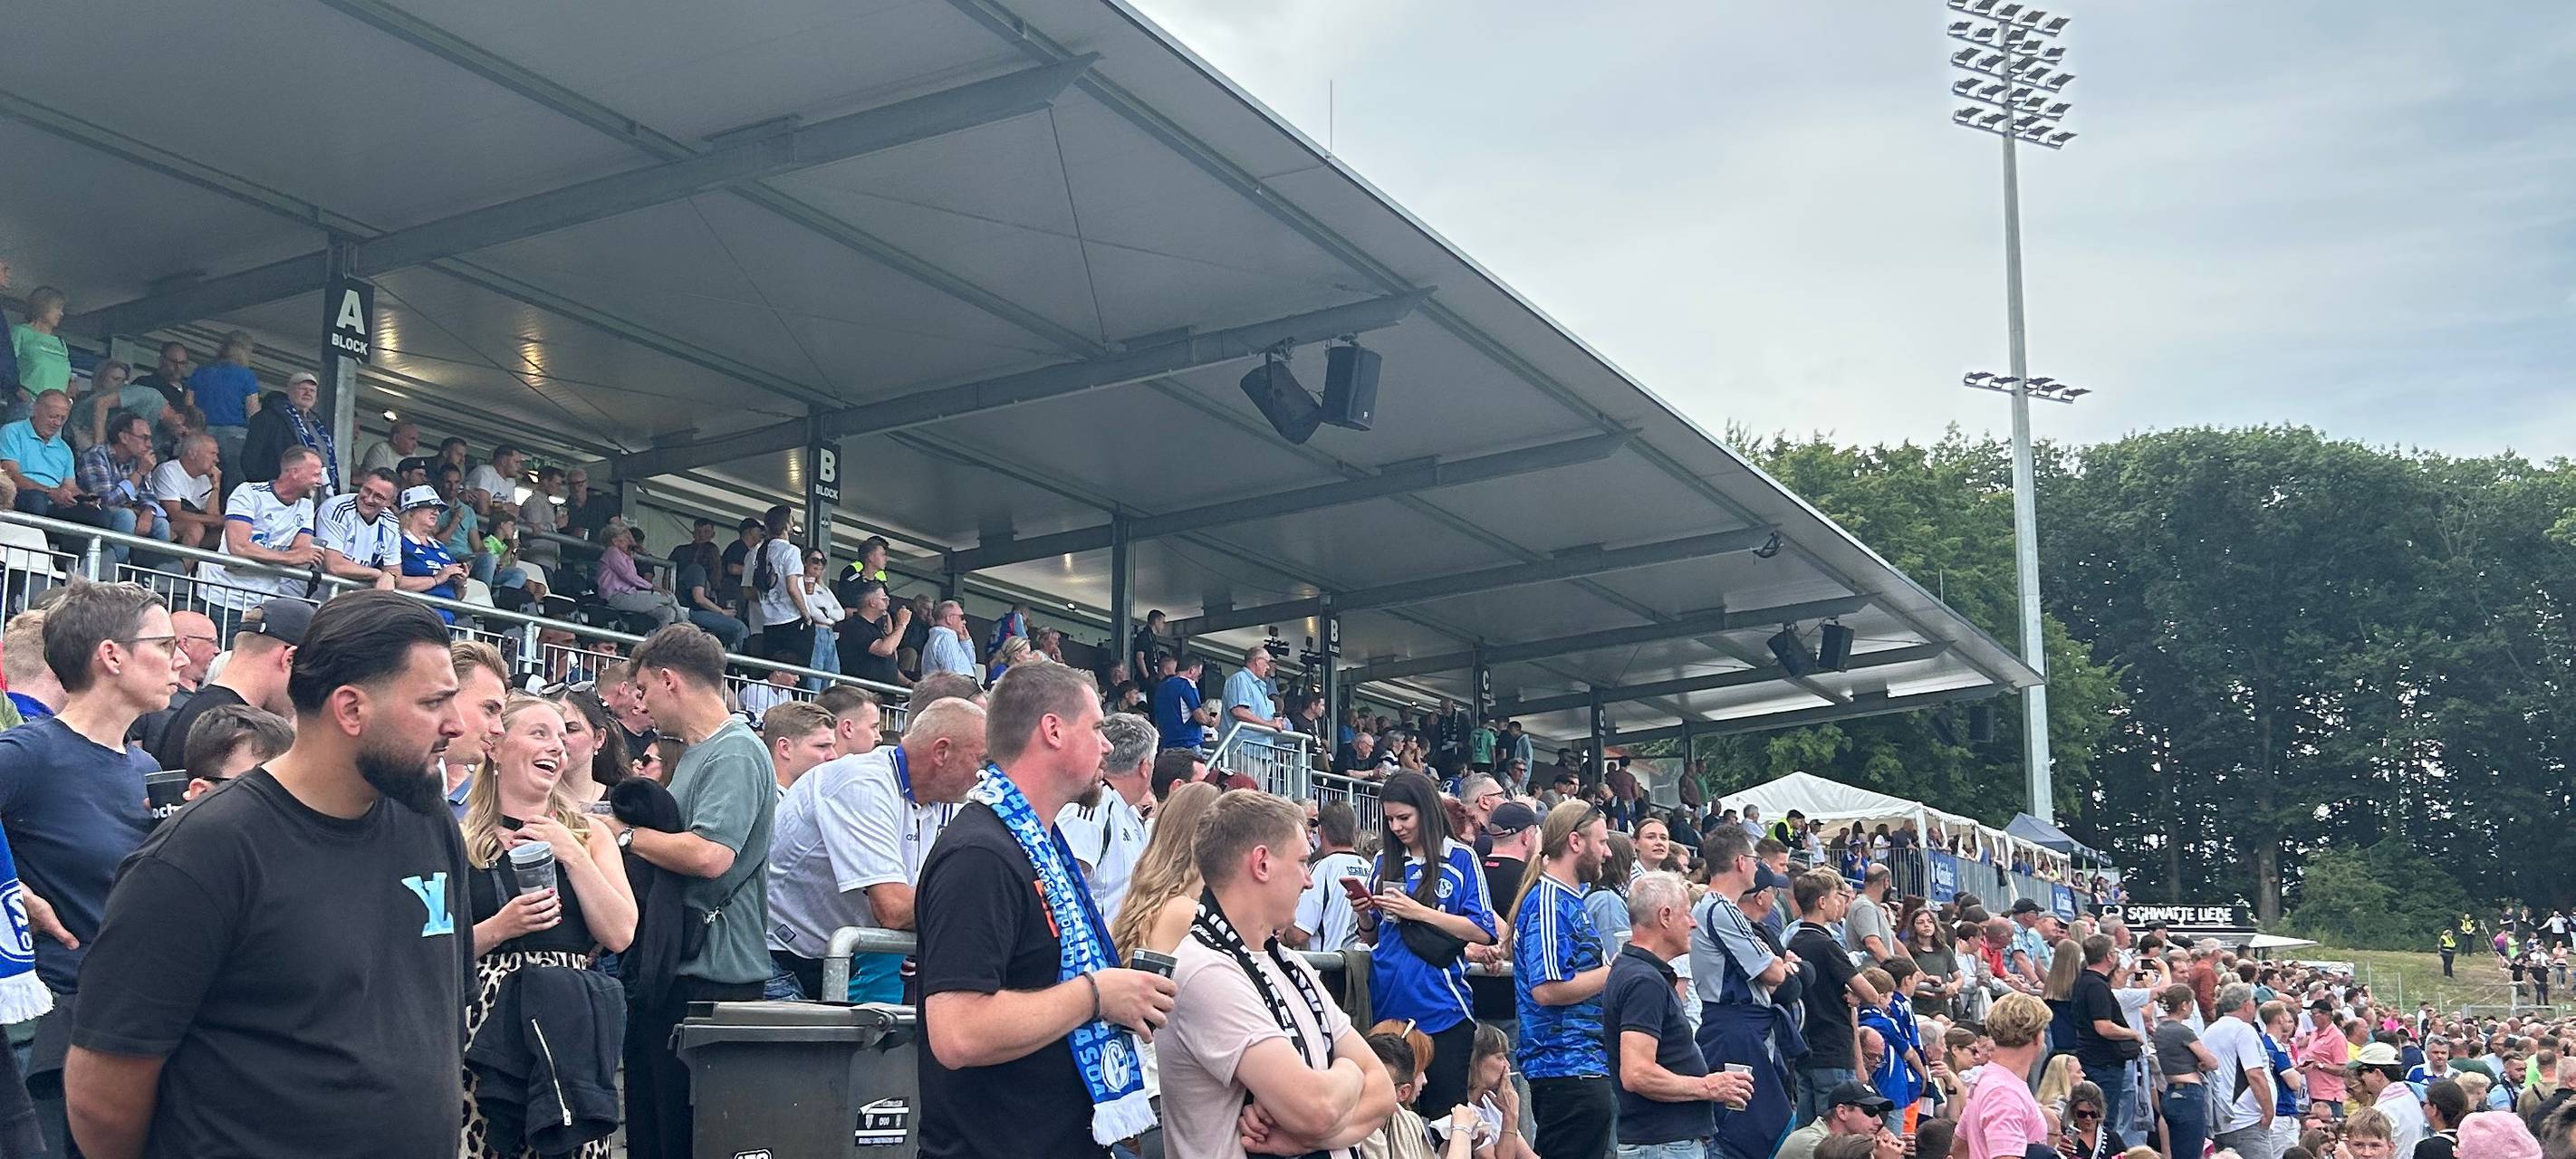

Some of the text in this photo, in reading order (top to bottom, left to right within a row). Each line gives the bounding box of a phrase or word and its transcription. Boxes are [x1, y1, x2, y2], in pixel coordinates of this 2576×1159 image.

[336, 289, 366, 335] A
[332, 332, 369, 355] BLOCK
[820, 447, 836, 483] B
[815, 484, 839, 500] BLOCK
[1331, 618, 1339, 642] B
[1483, 670, 1489, 690] C
[1599, 709, 1604, 727] C
[2198, 907, 2233, 922] LIEBE
